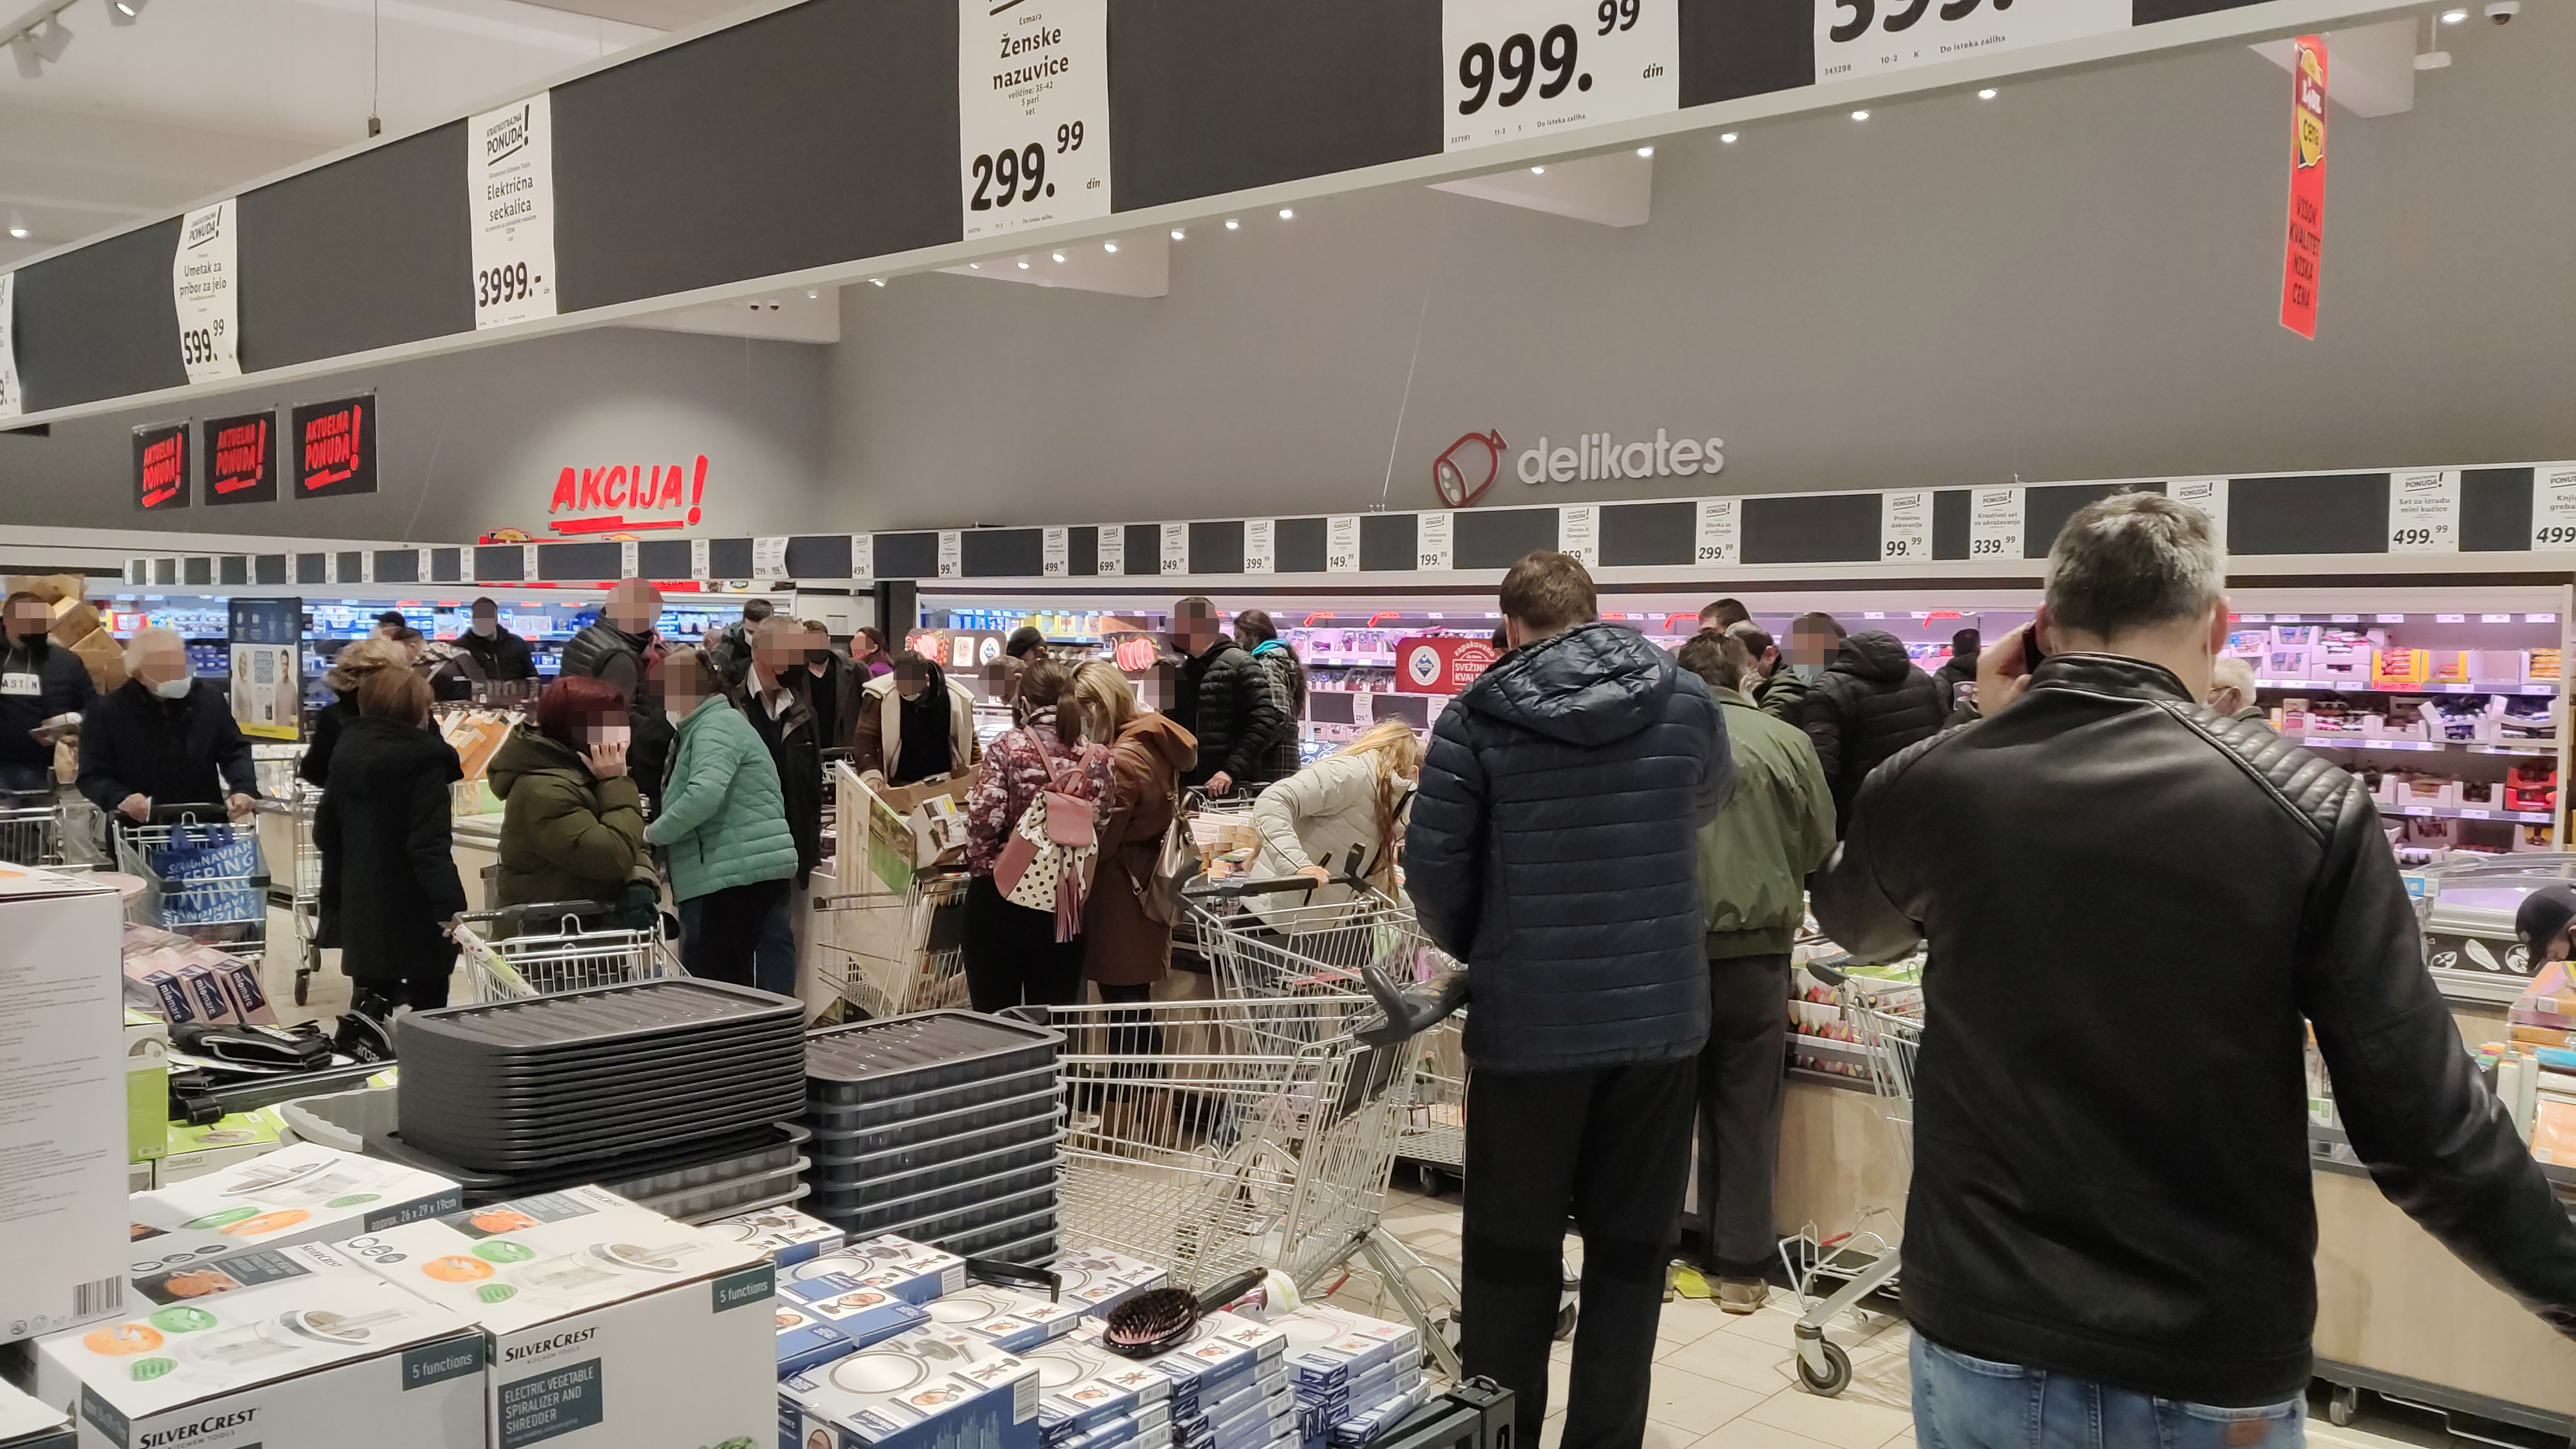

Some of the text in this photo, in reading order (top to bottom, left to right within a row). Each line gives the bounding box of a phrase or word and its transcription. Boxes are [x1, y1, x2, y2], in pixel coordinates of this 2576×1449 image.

[1019, 14, 1043, 25] Esmara
[1000, 26, 1061, 59] Ženske
[1940, 45, 1951, 53] Do
[1954, 40, 1979, 51] isteka
[1981, 34, 2006, 46] zaliha
[1459, 0, 1640, 115] 999. 99
[993, 55, 1069, 90] nazuvice
[1642, 63, 1663, 79] din
[971, 120, 1084, 211] 299. 99
[488, 176, 533, 200] Električna
[1086, 177, 1101, 190] din
[489, 198, 532, 222] seckalica
[184, 261, 222, 277] Umetak za
[180, 276, 227, 299] pribor za jelo
[184, 328, 218, 365] 599.
[213, 318, 224, 337] 99
[1517, 428, 1725, 484] delikates
[548, 454, 709, 525] AKCIJA!
[2393, 525, 2448, 545] 499. 99
[1698, 547, 1725, 560] 299.
[1886, 541, 1910, 556] 99.
[1973, 540, 2004, 554] 339.
[941, 564, 952, 574] 99.
[1100, 561, 1115, 571] 699.
[1162, 560, 1179, 570] 249.
[1246, 558, 1264, 569] 399.
[1329, 556, 1347, 567] 149.
[1420, 554, 1439, 566] 199.
[401, 1209, 410, 1222] 26
[412, 1209, 417, 1218] x
[419, 1205, 428, 1218] 29
[430, 1206, 435, 1214] x
[720, 1280, 768, 1303] 5 functions
[527, 1346, 580, 1365] KITCHEN TOOLS
[412, 1354, 473, 1379] 5 functions
[505, 1366, 594, 1404] ELECTRIC VEGETABLE
[506, 1385, 582, 1419] SPIRALIZER AND
[506, 1408, 557, 1435] SHREDDER
[208, 1430, 235, 1442] TOOLS
